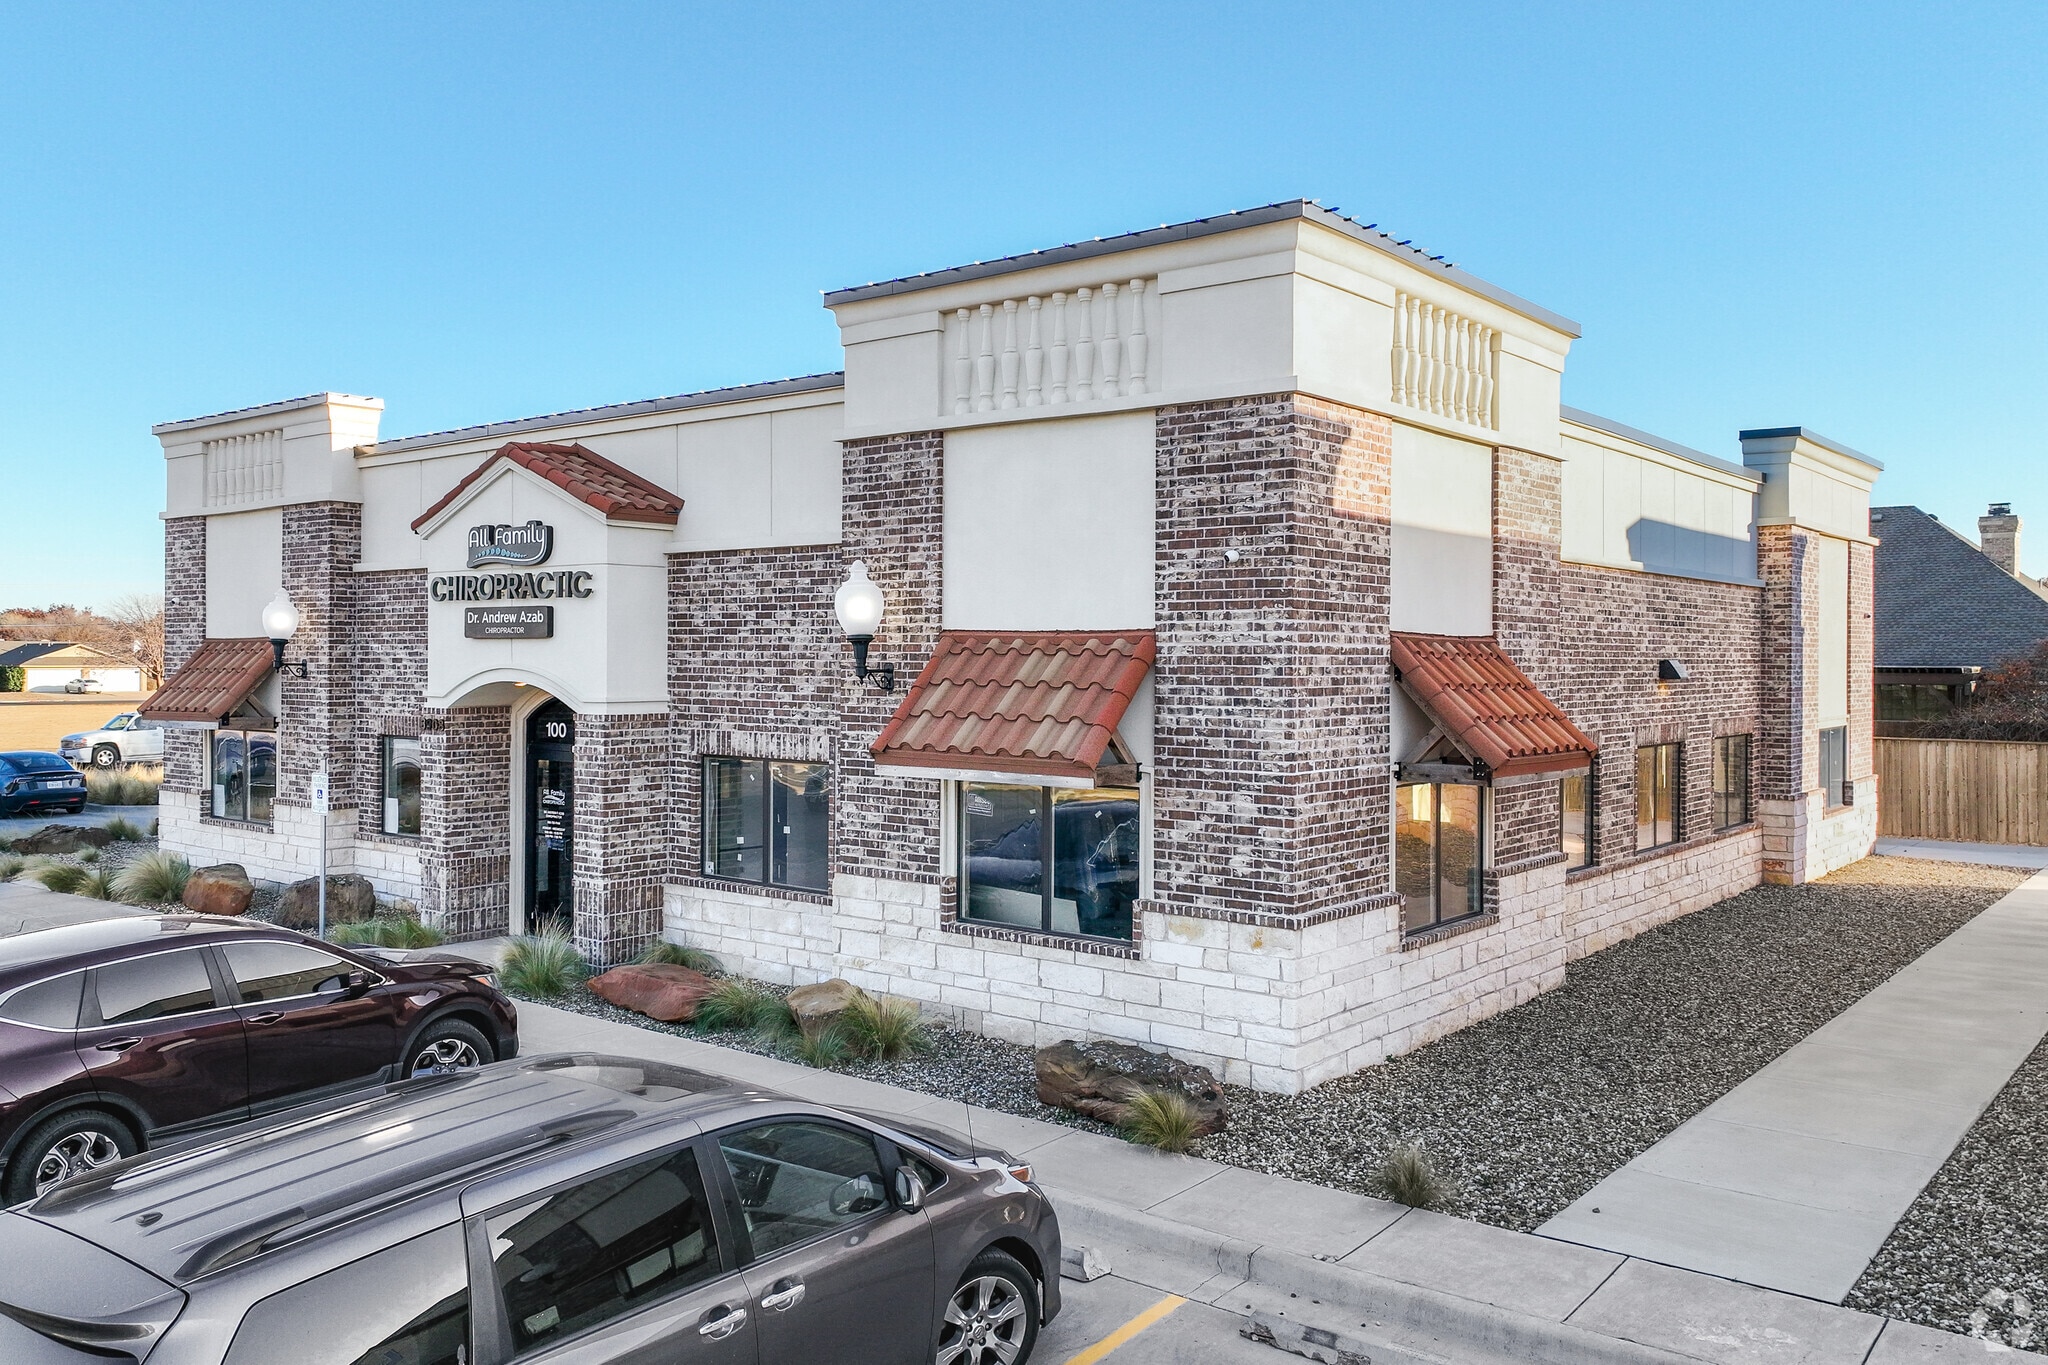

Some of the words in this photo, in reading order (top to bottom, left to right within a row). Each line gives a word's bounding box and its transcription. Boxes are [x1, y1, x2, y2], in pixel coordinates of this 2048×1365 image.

[469, 528, 489, 548] All
[495, 524, 545, 546] Family
[430, 571, 593, 602] CHIROPRACTIC
[467, 611, 480, 624] Dr.
[482, 611, 517, 624] Andrew
[519, 610, 544, 623] Azab
[485, 626, 525, 634] CHIROPRACTOR
[545, 721, 567, 738] 100
